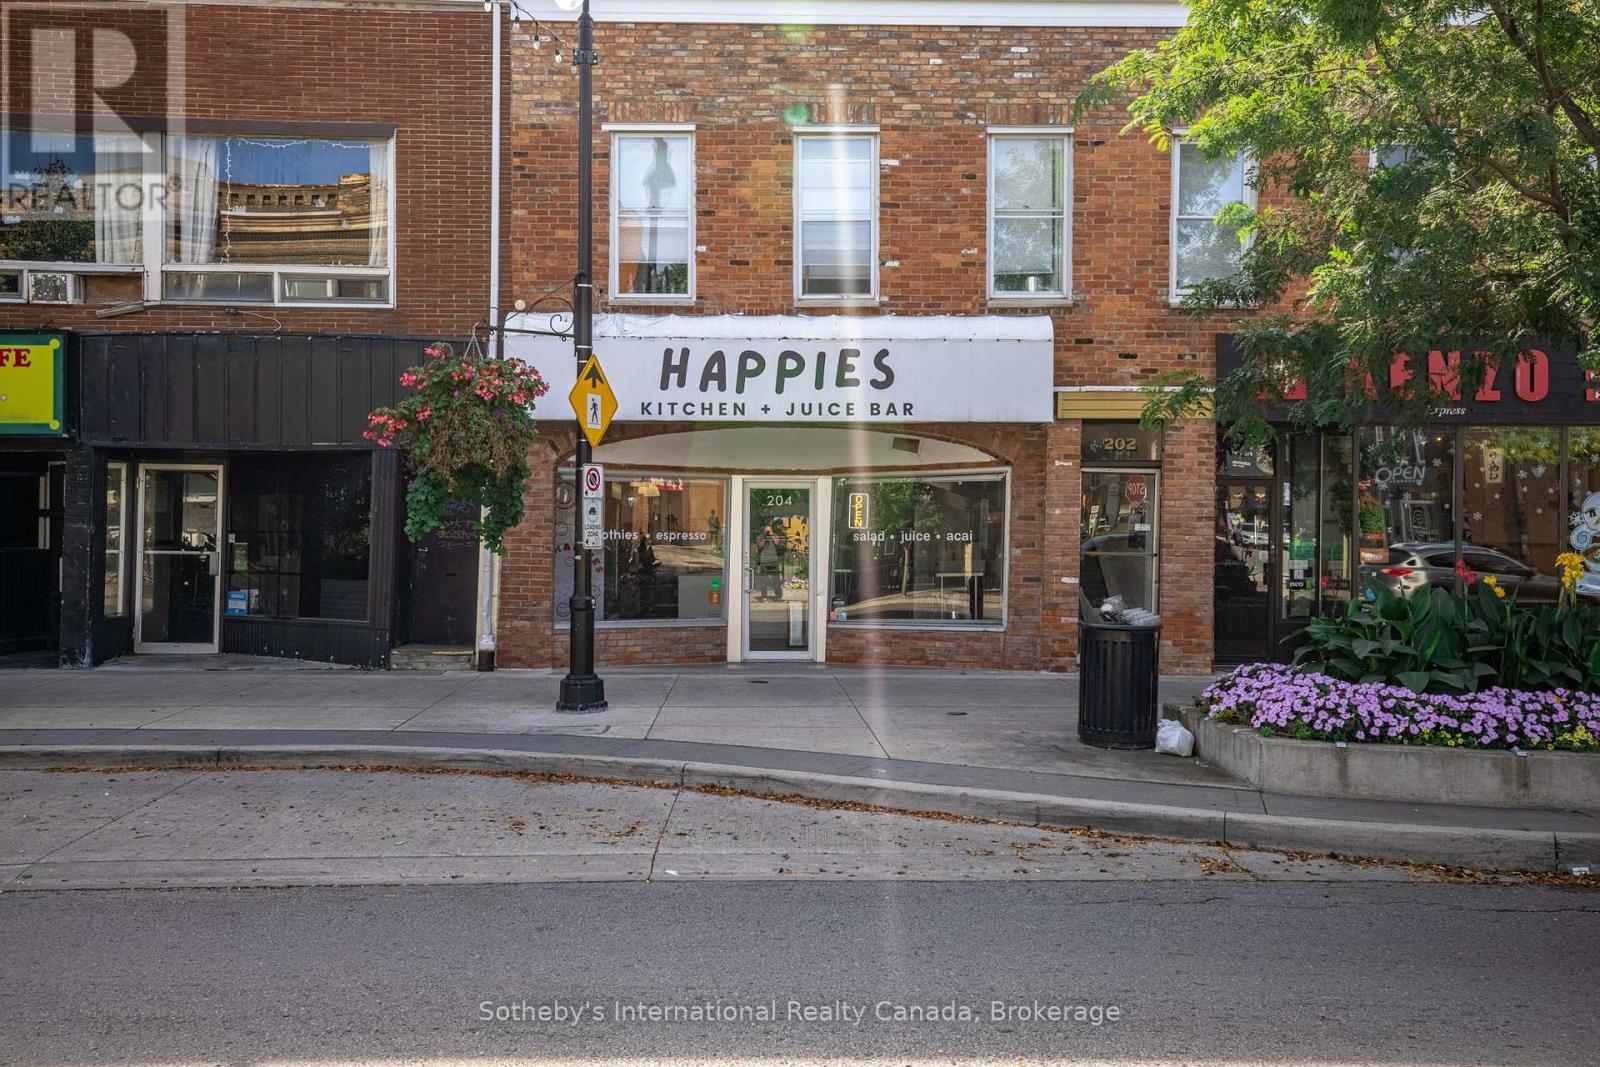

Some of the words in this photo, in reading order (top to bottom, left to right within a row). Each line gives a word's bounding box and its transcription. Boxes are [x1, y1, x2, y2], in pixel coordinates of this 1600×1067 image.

[659, 347, 895, 395] HAPPIES
[641, 402, 746, 416] KITCHEN
[785, 402, 855, 416] JUICE
[870, 402, 914, 416] BAR
[1104, 438, 1137, 451] 202
[1375, 466, 1426, 482] OPEN
[766, 495, 793, 506] 204
[854, 495, 863, 528] OPEN
[656, 532, 707, 542] espresso
[853, 530, 885, 542] salad
[900, 530, 931, 544] juice
[946, 530, 973, 541] acai
